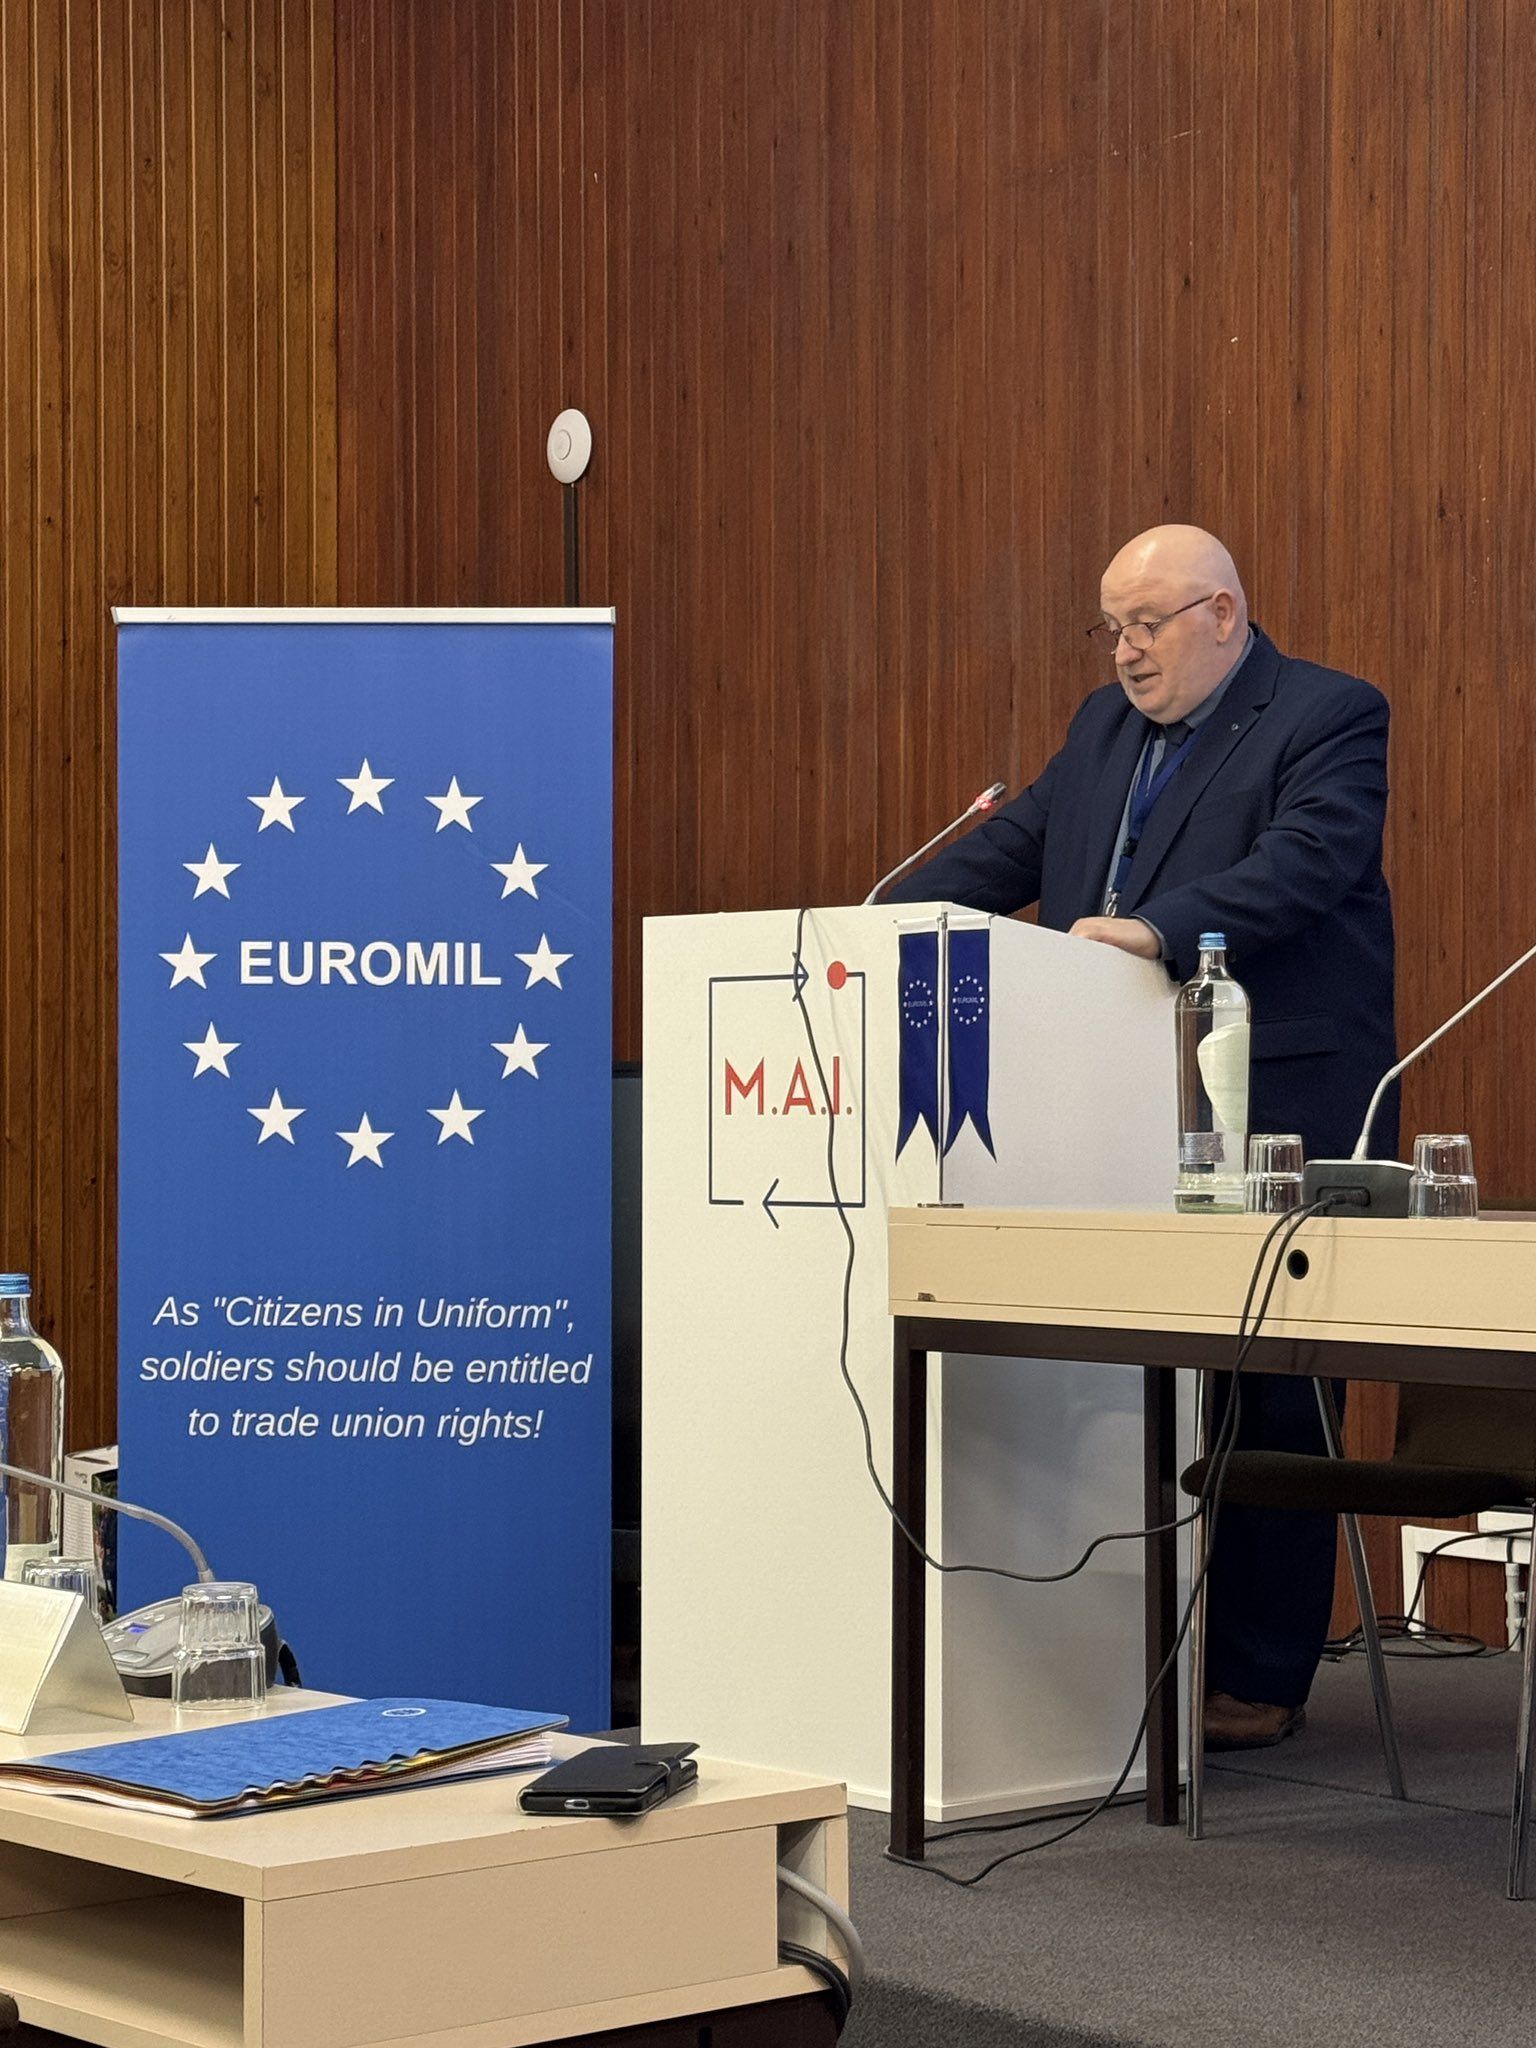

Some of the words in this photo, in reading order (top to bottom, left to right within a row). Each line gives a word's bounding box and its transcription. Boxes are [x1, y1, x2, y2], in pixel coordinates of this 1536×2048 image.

[239, 940, 503, 987] EUROMIL
[725, 1056, 852, 1116] M.A.I.
[153, 1296, 200, 1327] As
[214, 1296, 363, 1327] "Citizens
[374, 1296, 404, 1327] in
[417, 1297, 575, 1334] Uniform",
[139, 1350, 275, 1383] soldiers
[284, 1351, 402, 1383] should
[410, 1351, 454, 1383] be
[465, 1352, 593, 1384] entitled
[188, 1408, 220, 1437] to
[231, 1406, 319, 1437] trade
[331, 1407, 425, 1438] union
[436, 1407, 544, 1446] rights!
